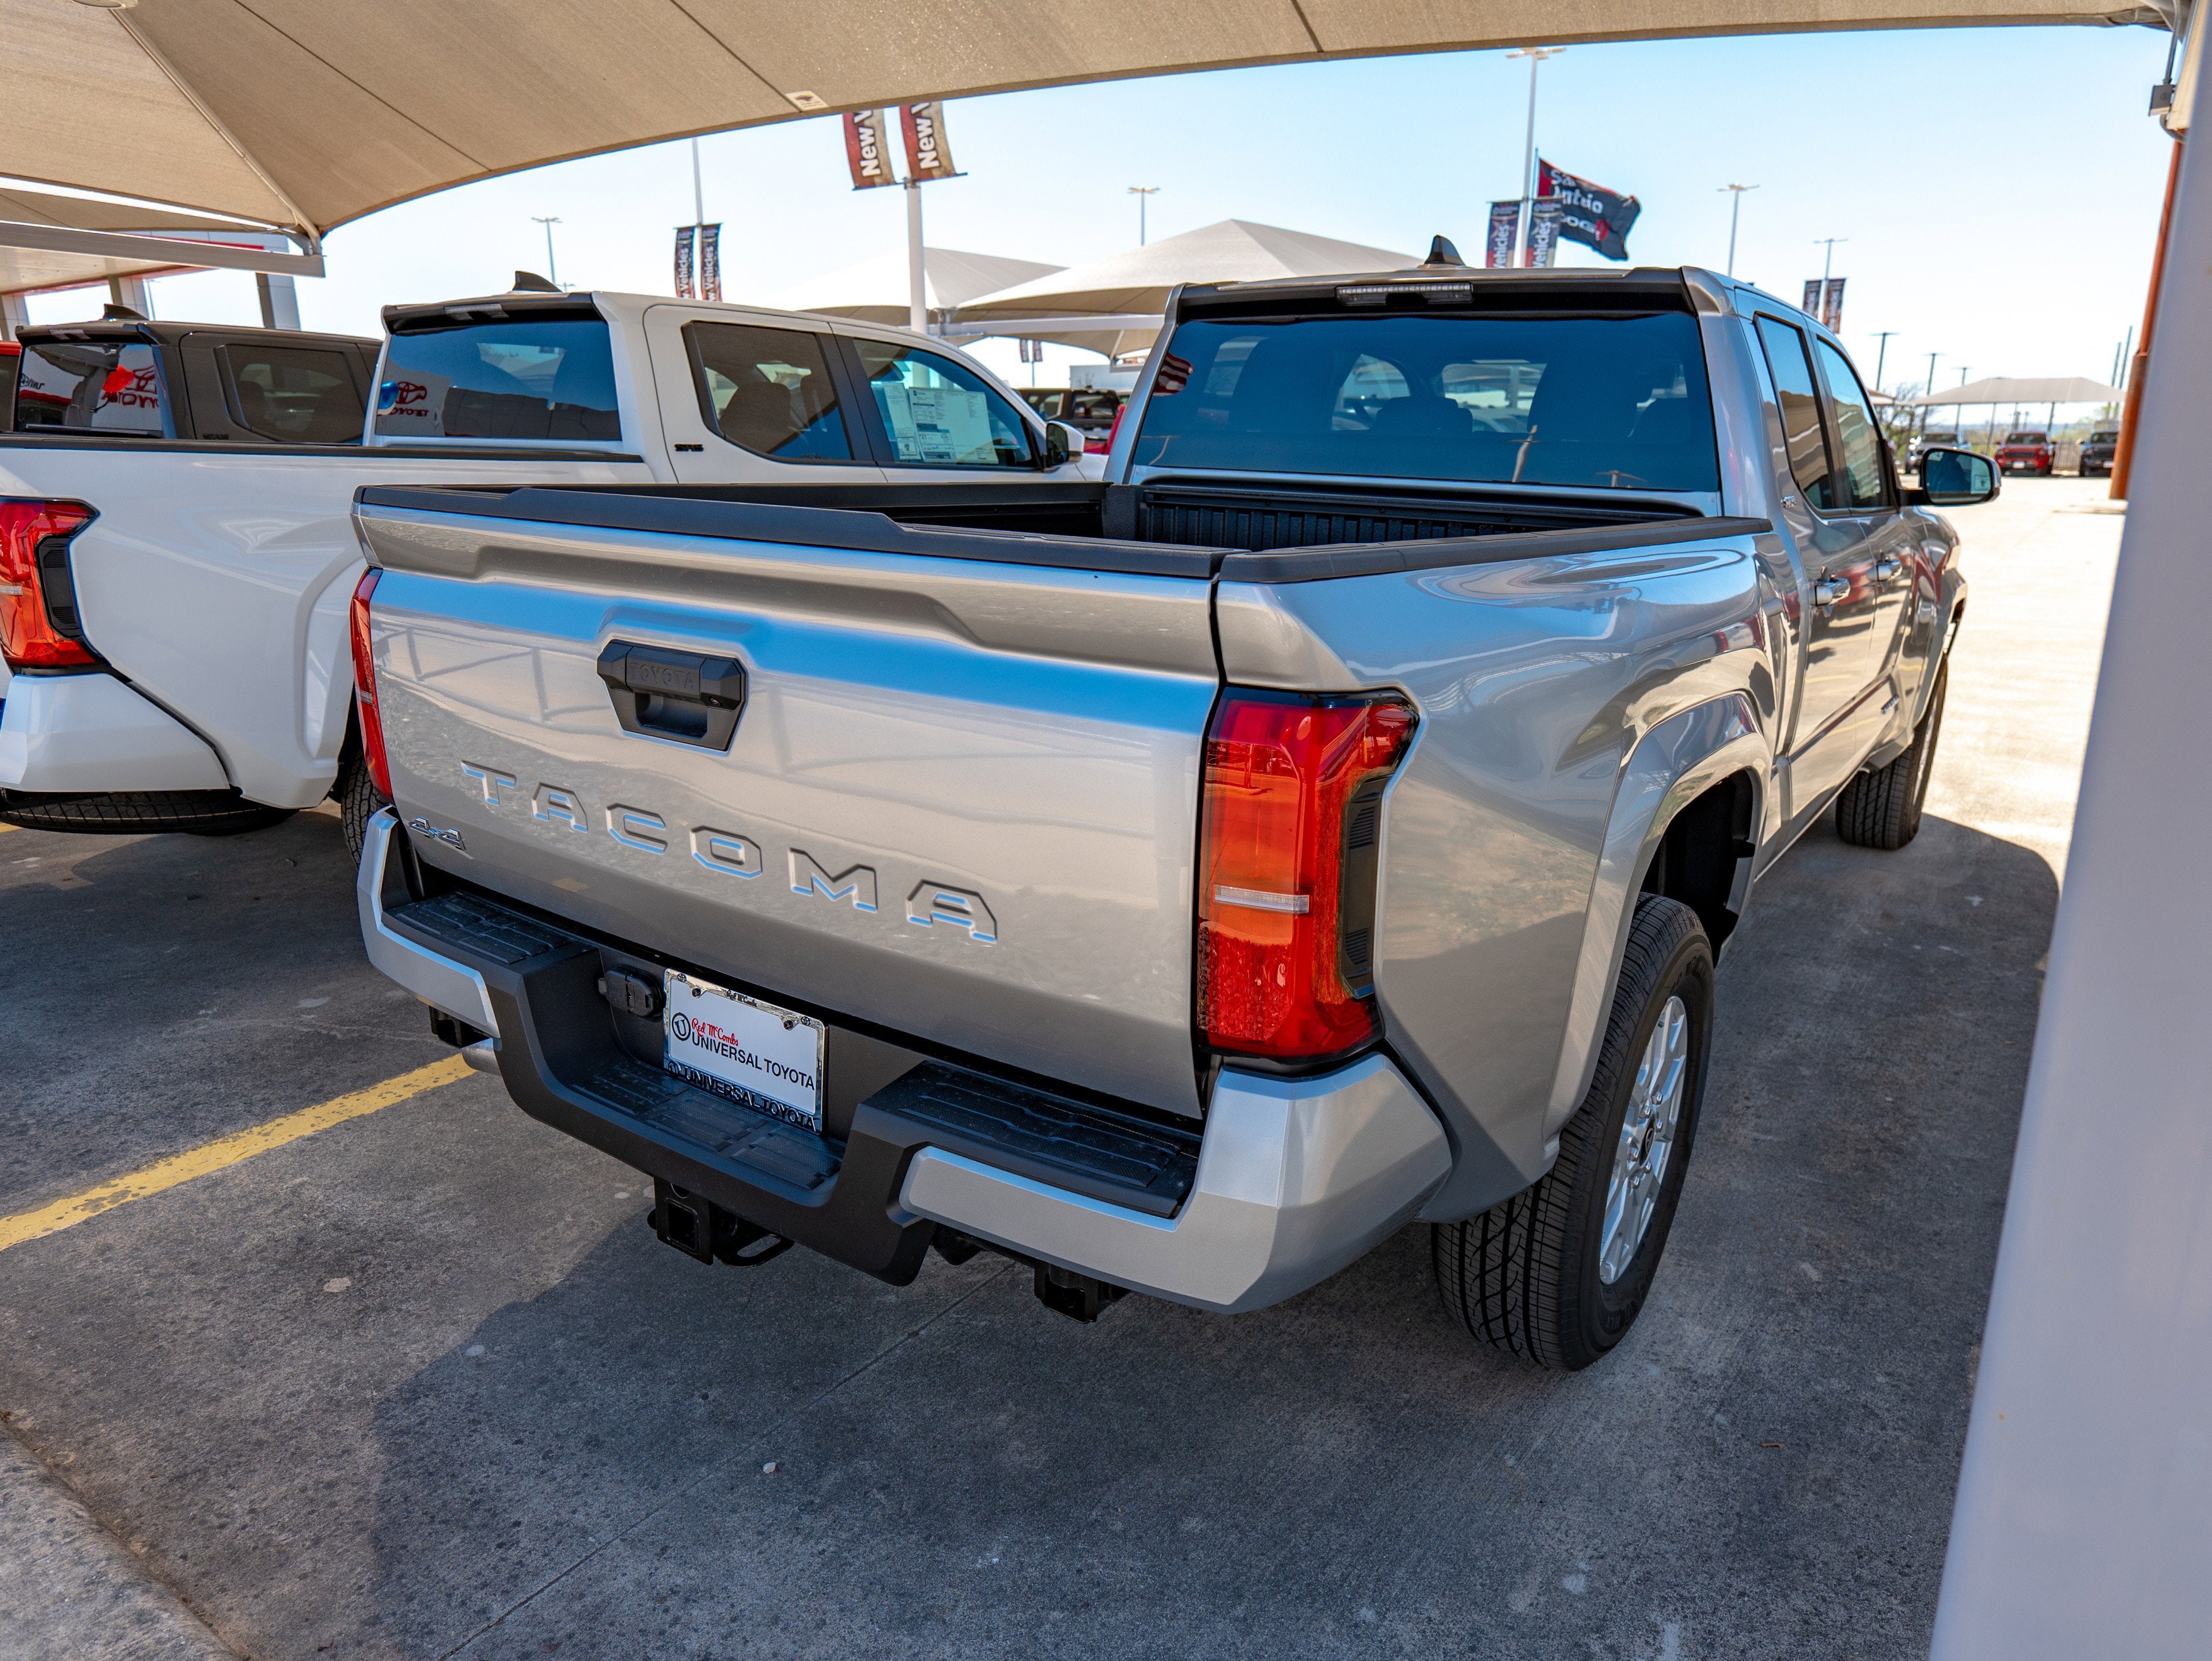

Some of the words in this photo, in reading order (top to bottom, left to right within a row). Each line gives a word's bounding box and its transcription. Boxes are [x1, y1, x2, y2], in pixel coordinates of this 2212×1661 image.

[859, 127, 881, 177] New
[916, 118, 940, 169] New
[677, 246, 690, 291] Vehicles
[703, 245, 715, 290] Vehicles
[630, 663, 696, 690] TOYOTA
[461, 760, 997, 943] TACOMA
[692, 1017, 706, 1037] Red
[706, 1023, 738, 1047] McCombs
[692, 1031, 762, 1071] UNIVERSAL
[764, 1058, 815, 1091] TOYOTA
[684, 1066, 760, 1108] UNIVERSAL
[760, 1096, 816, 1132] TOYOTA
